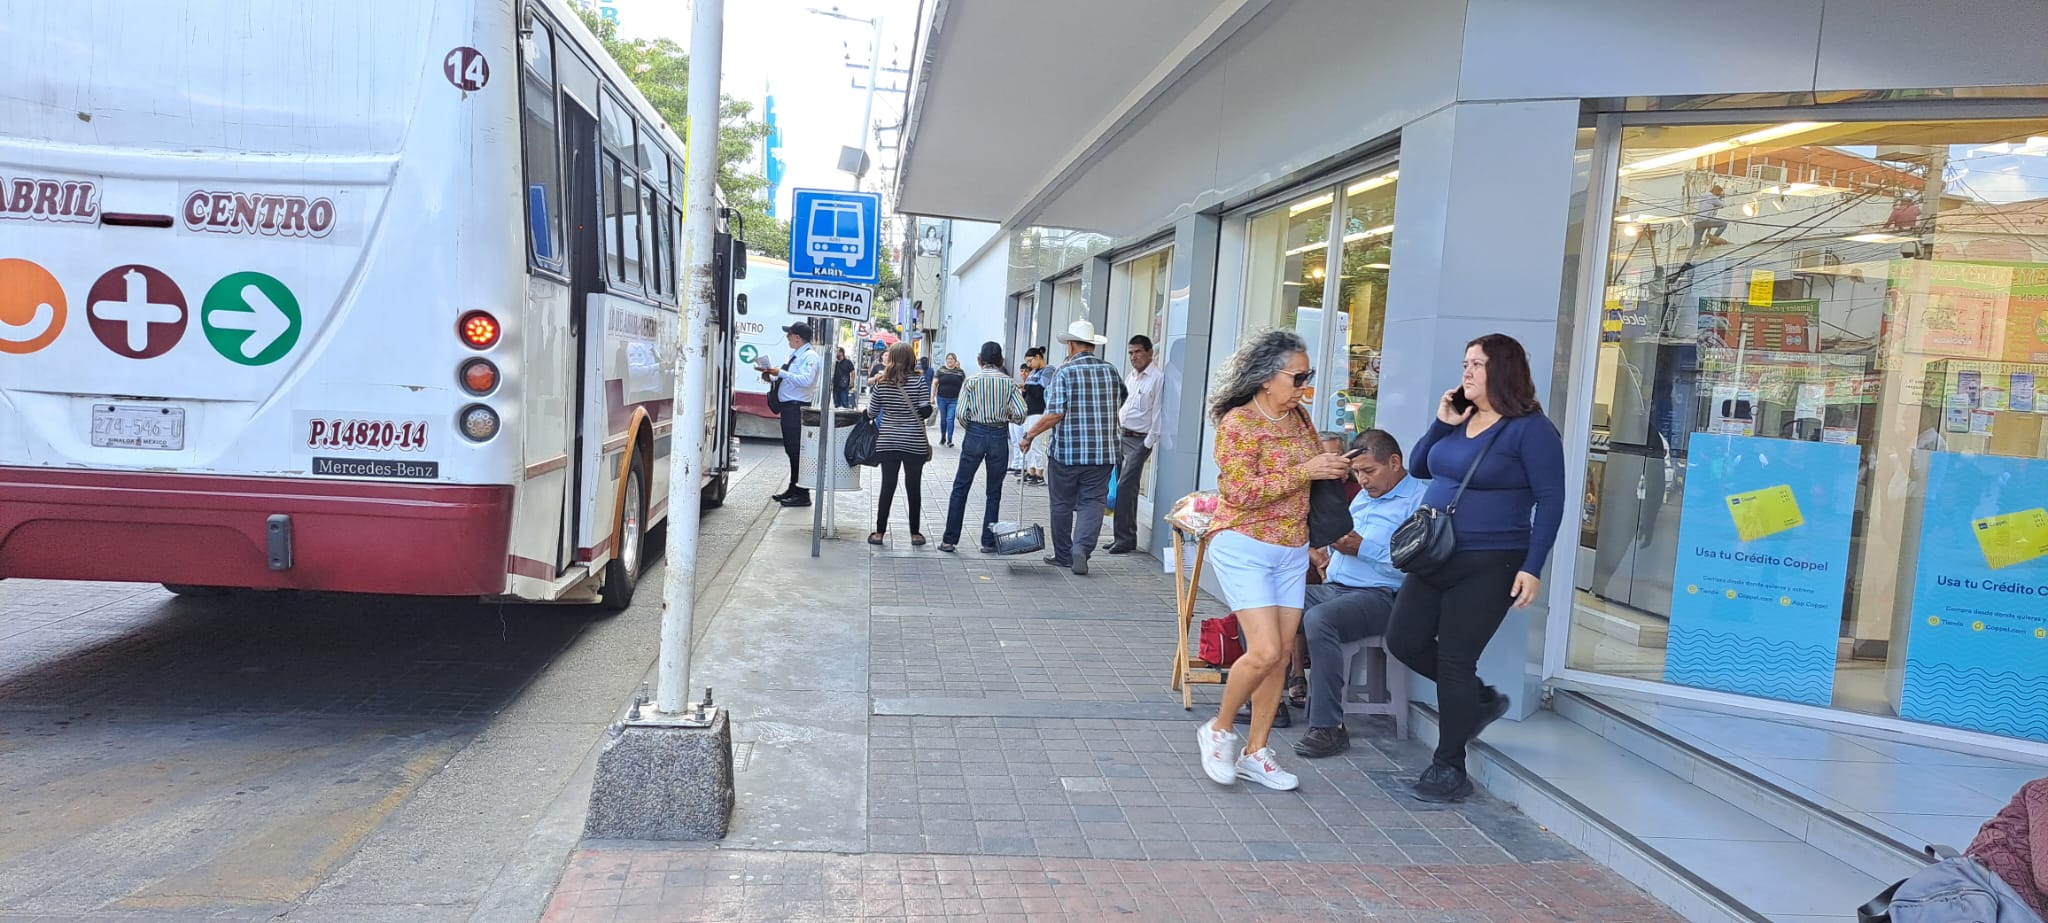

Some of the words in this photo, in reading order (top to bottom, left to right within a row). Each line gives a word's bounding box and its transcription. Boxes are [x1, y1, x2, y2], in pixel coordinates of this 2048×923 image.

[448, 50, 485, 88] 14
[184, 190, 332, 232] CENTRO
[796, 286, 864, 304] PRINCIPIA
[797, 300, 861, 316] PARADERO
[308, 419, 427, 449] P.14820-14
[318, 459, 434, 478] Mercedes-Benz
[1695, 546, 1717, 559] Usa
[1719, 549, 1732, 560] tu
[1734, 551, 1781, 566] Crédito
[1783, 557, 1829, 572] Coppel
[1699, 586, 1719, 595] Tienda
[1737, 592, 1774, 603] Coppel.com
[1937, 575, 1961, 587] Usa
[1965, 579, 1978, 589] tu
[1982, 580, 2035, 596] Crédito
[1945, 605, 1973, 615] Compra
[1973, 608, 1993, 617] desde
[1993, 611, 2016, 619] donde
[2016, 614, 2041, 623] quieras
[1941, 619, 1964, 628] Tienda
[1985, 624, 2027, 635] Coppel.com
